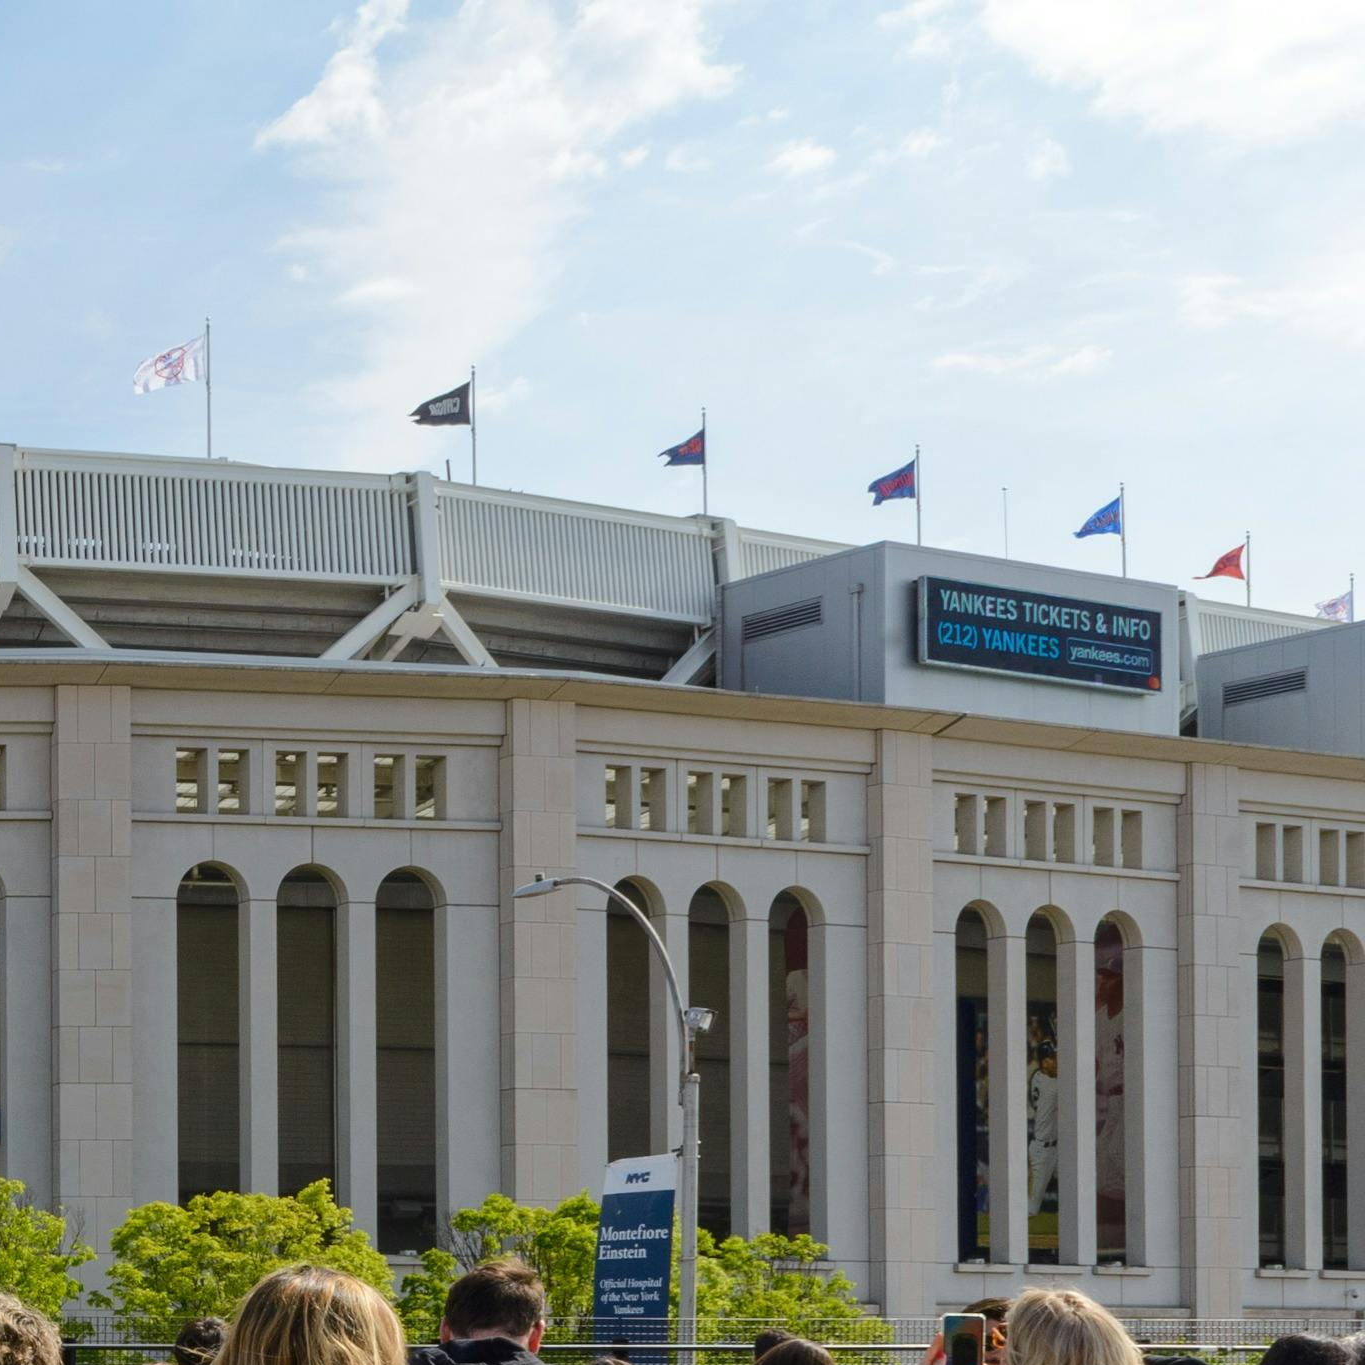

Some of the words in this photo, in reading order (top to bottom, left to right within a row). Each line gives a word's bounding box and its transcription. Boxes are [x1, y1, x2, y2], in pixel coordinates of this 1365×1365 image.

[940, 589, 1018, 621] YANKEES
[1022, 601, 1090, 632] TICKETS
[1095, 612, 1108, 635] &
[1113, 617, 1151, 641] INFO
[937, 622, 978, 650] (212)
[982, 627, 1060, 659] YANKEES
[1069, 643, 1150, 669] yankees.com
[625, 1171, 651, 1185] NYC
[600, 1224, 669, 1243] Montefiore
[598, 1243, 648, 1261] Einstein
[599, 1278, 627, 1290] Official
[627, 1277, 662, 1290] Hospital
[621, 1292, 639, 1302] New
[640, 1290, 660, 1302] York
